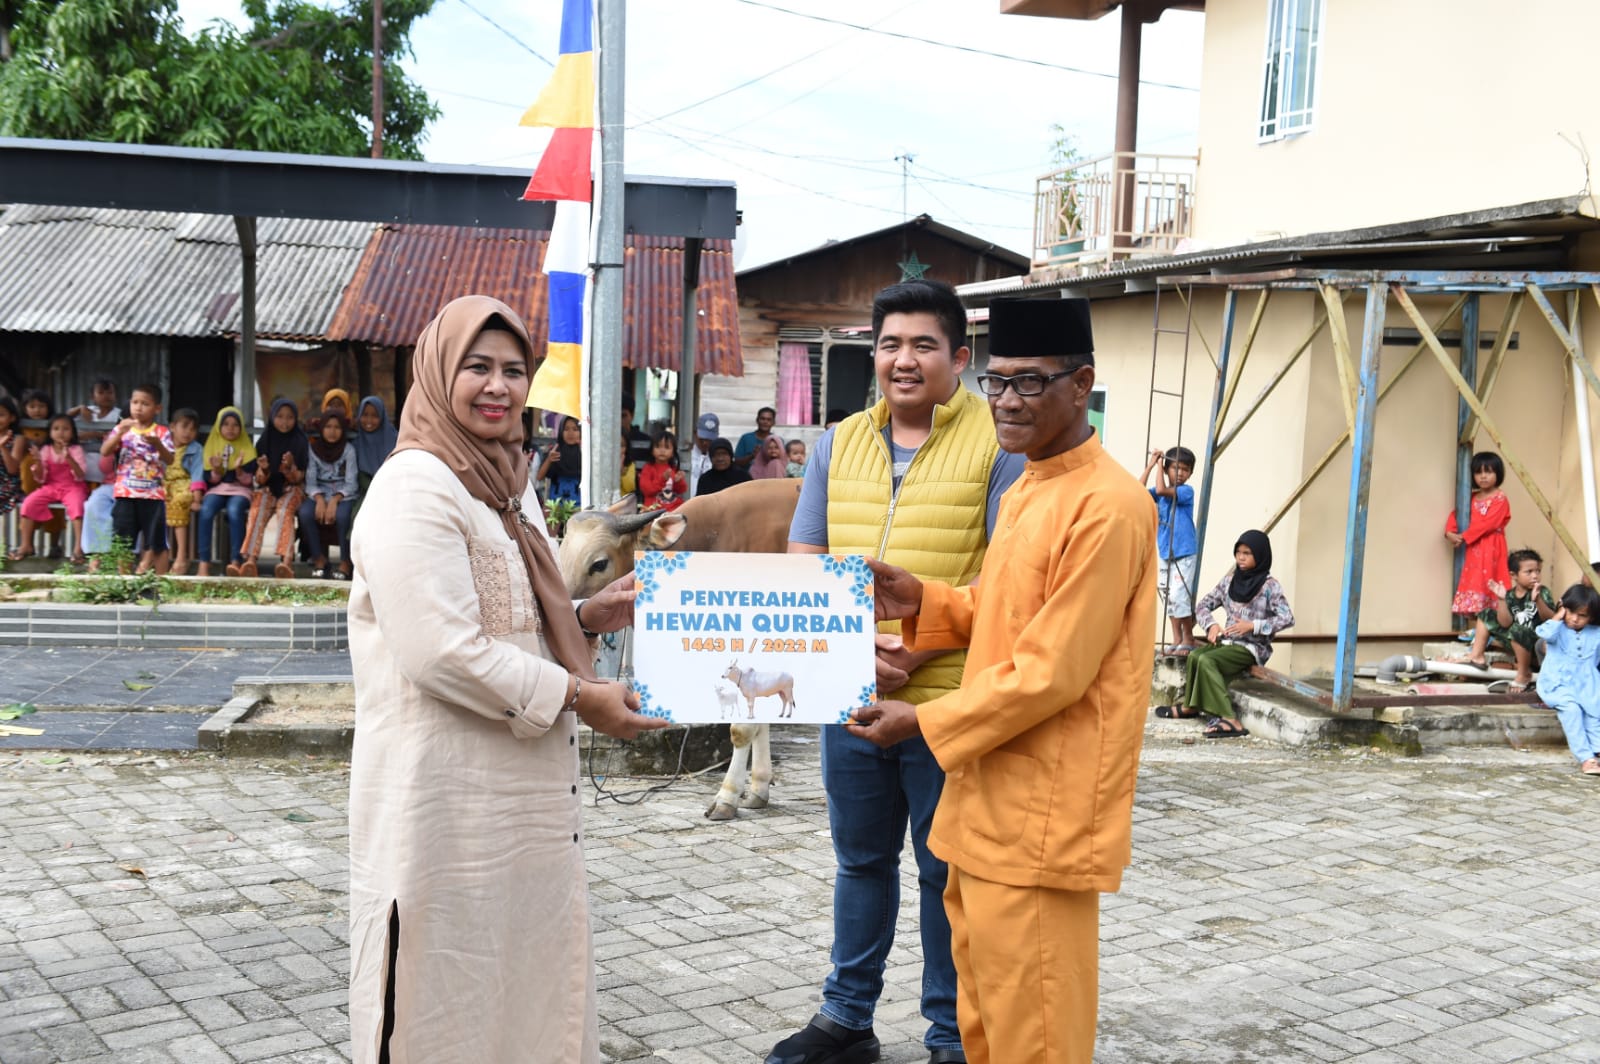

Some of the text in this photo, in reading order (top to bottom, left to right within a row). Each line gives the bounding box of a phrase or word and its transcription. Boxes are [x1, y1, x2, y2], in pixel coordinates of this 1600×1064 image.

[680, 590, 830, 608] PENYERAHAN
[645, 612, 864, 633] HEWAN QURBAN
[682, 637, 829, 653] 1443 H / 2022 M
